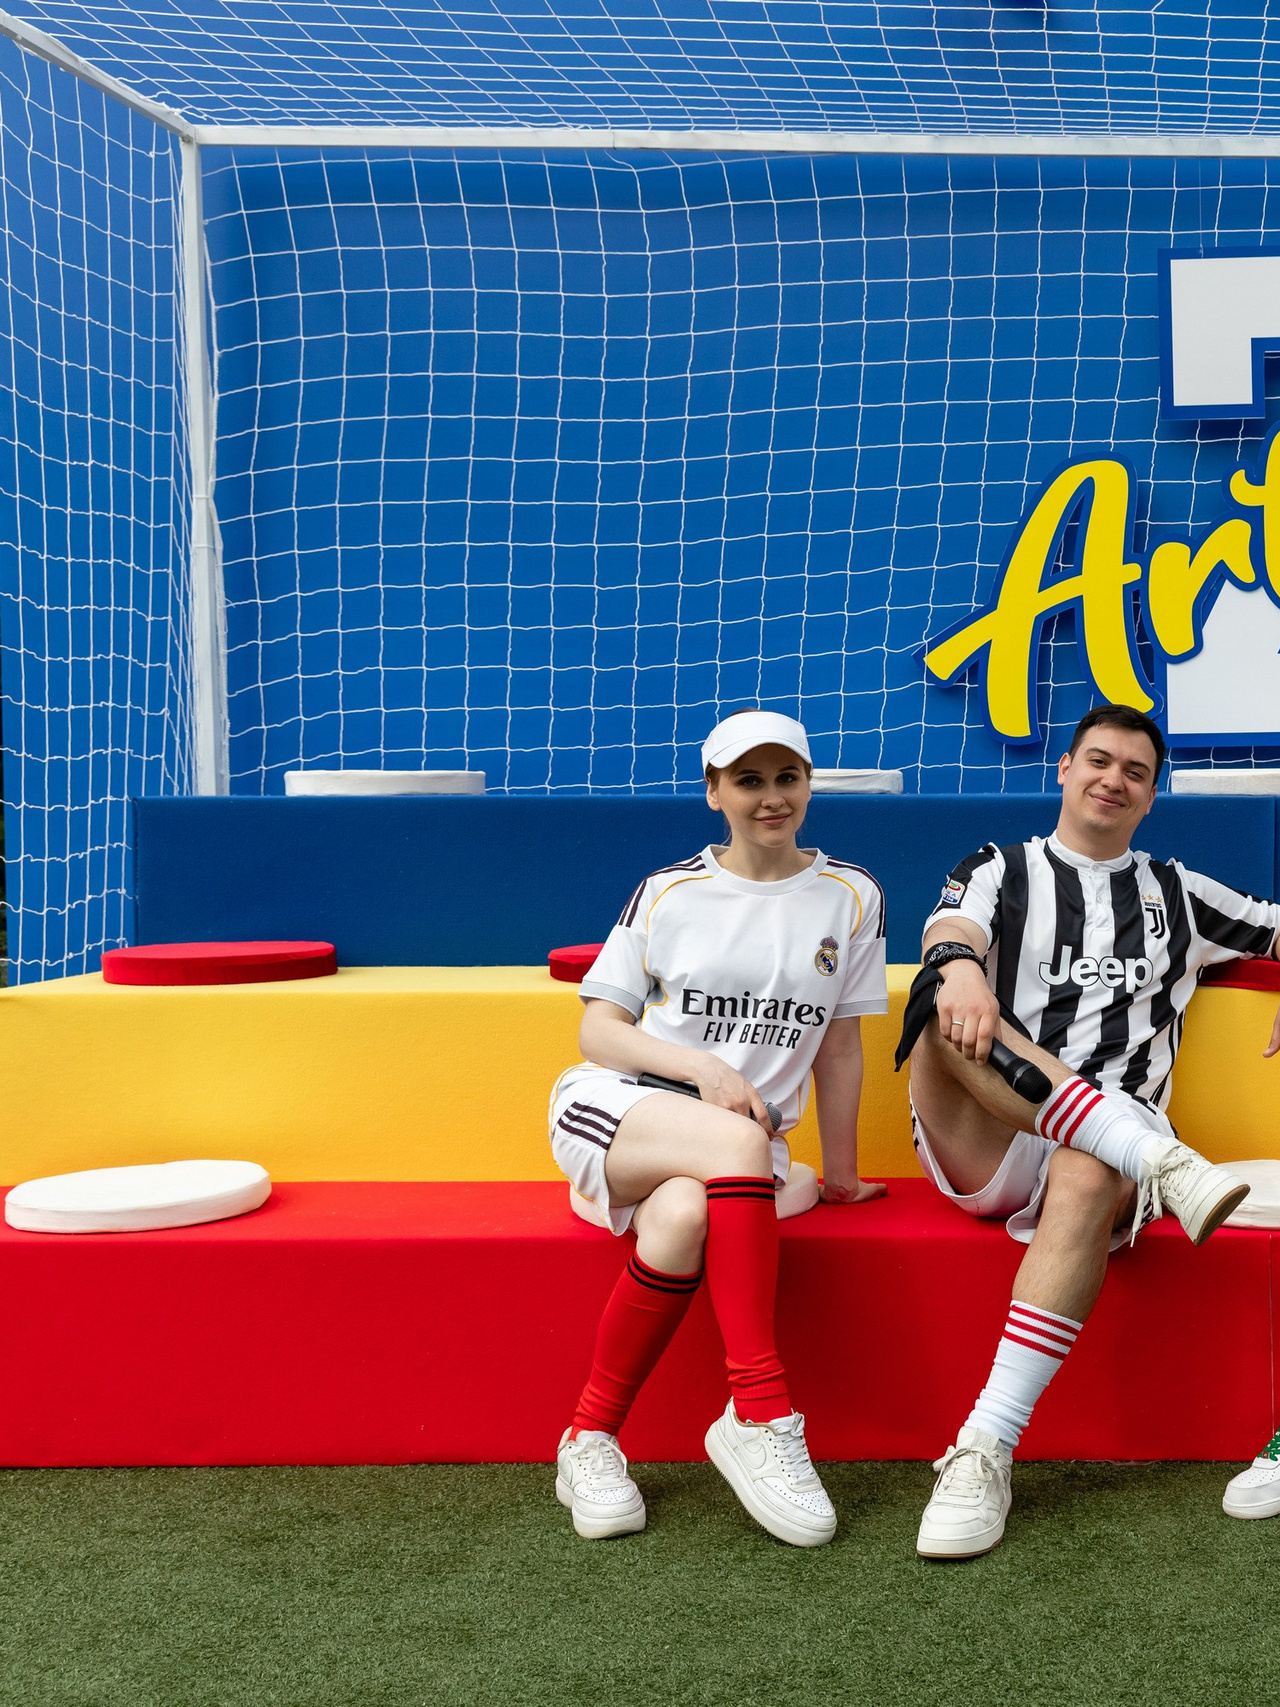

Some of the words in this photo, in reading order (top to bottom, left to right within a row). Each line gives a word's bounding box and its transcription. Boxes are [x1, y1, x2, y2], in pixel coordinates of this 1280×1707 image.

[1038, 944, 1154, 994] Jeep
[681, 988, 827, 1027] Emirates
[703, 1021, 737, 1043] FLY
[738, 1023, 802, 1050] BETTER
